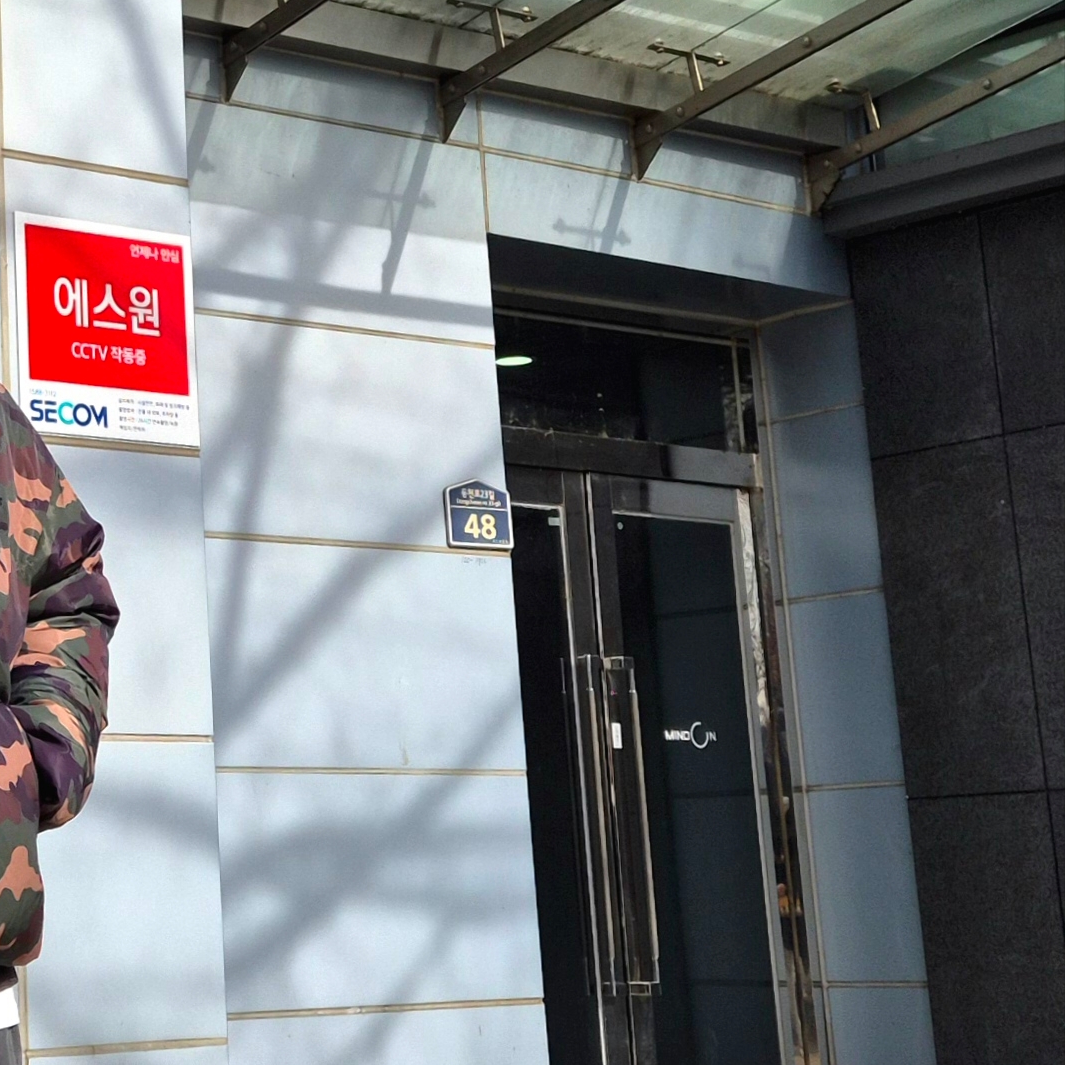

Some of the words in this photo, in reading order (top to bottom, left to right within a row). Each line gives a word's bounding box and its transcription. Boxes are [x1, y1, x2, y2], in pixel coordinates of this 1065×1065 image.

[53, 276, 161, 337] 에스원
[71, 341, 109, 361] CCTV
[110, 346, 147, 366] 작동중
[29, 399, 108, 429] SECOM
[464, 513, 497, 540] 48
